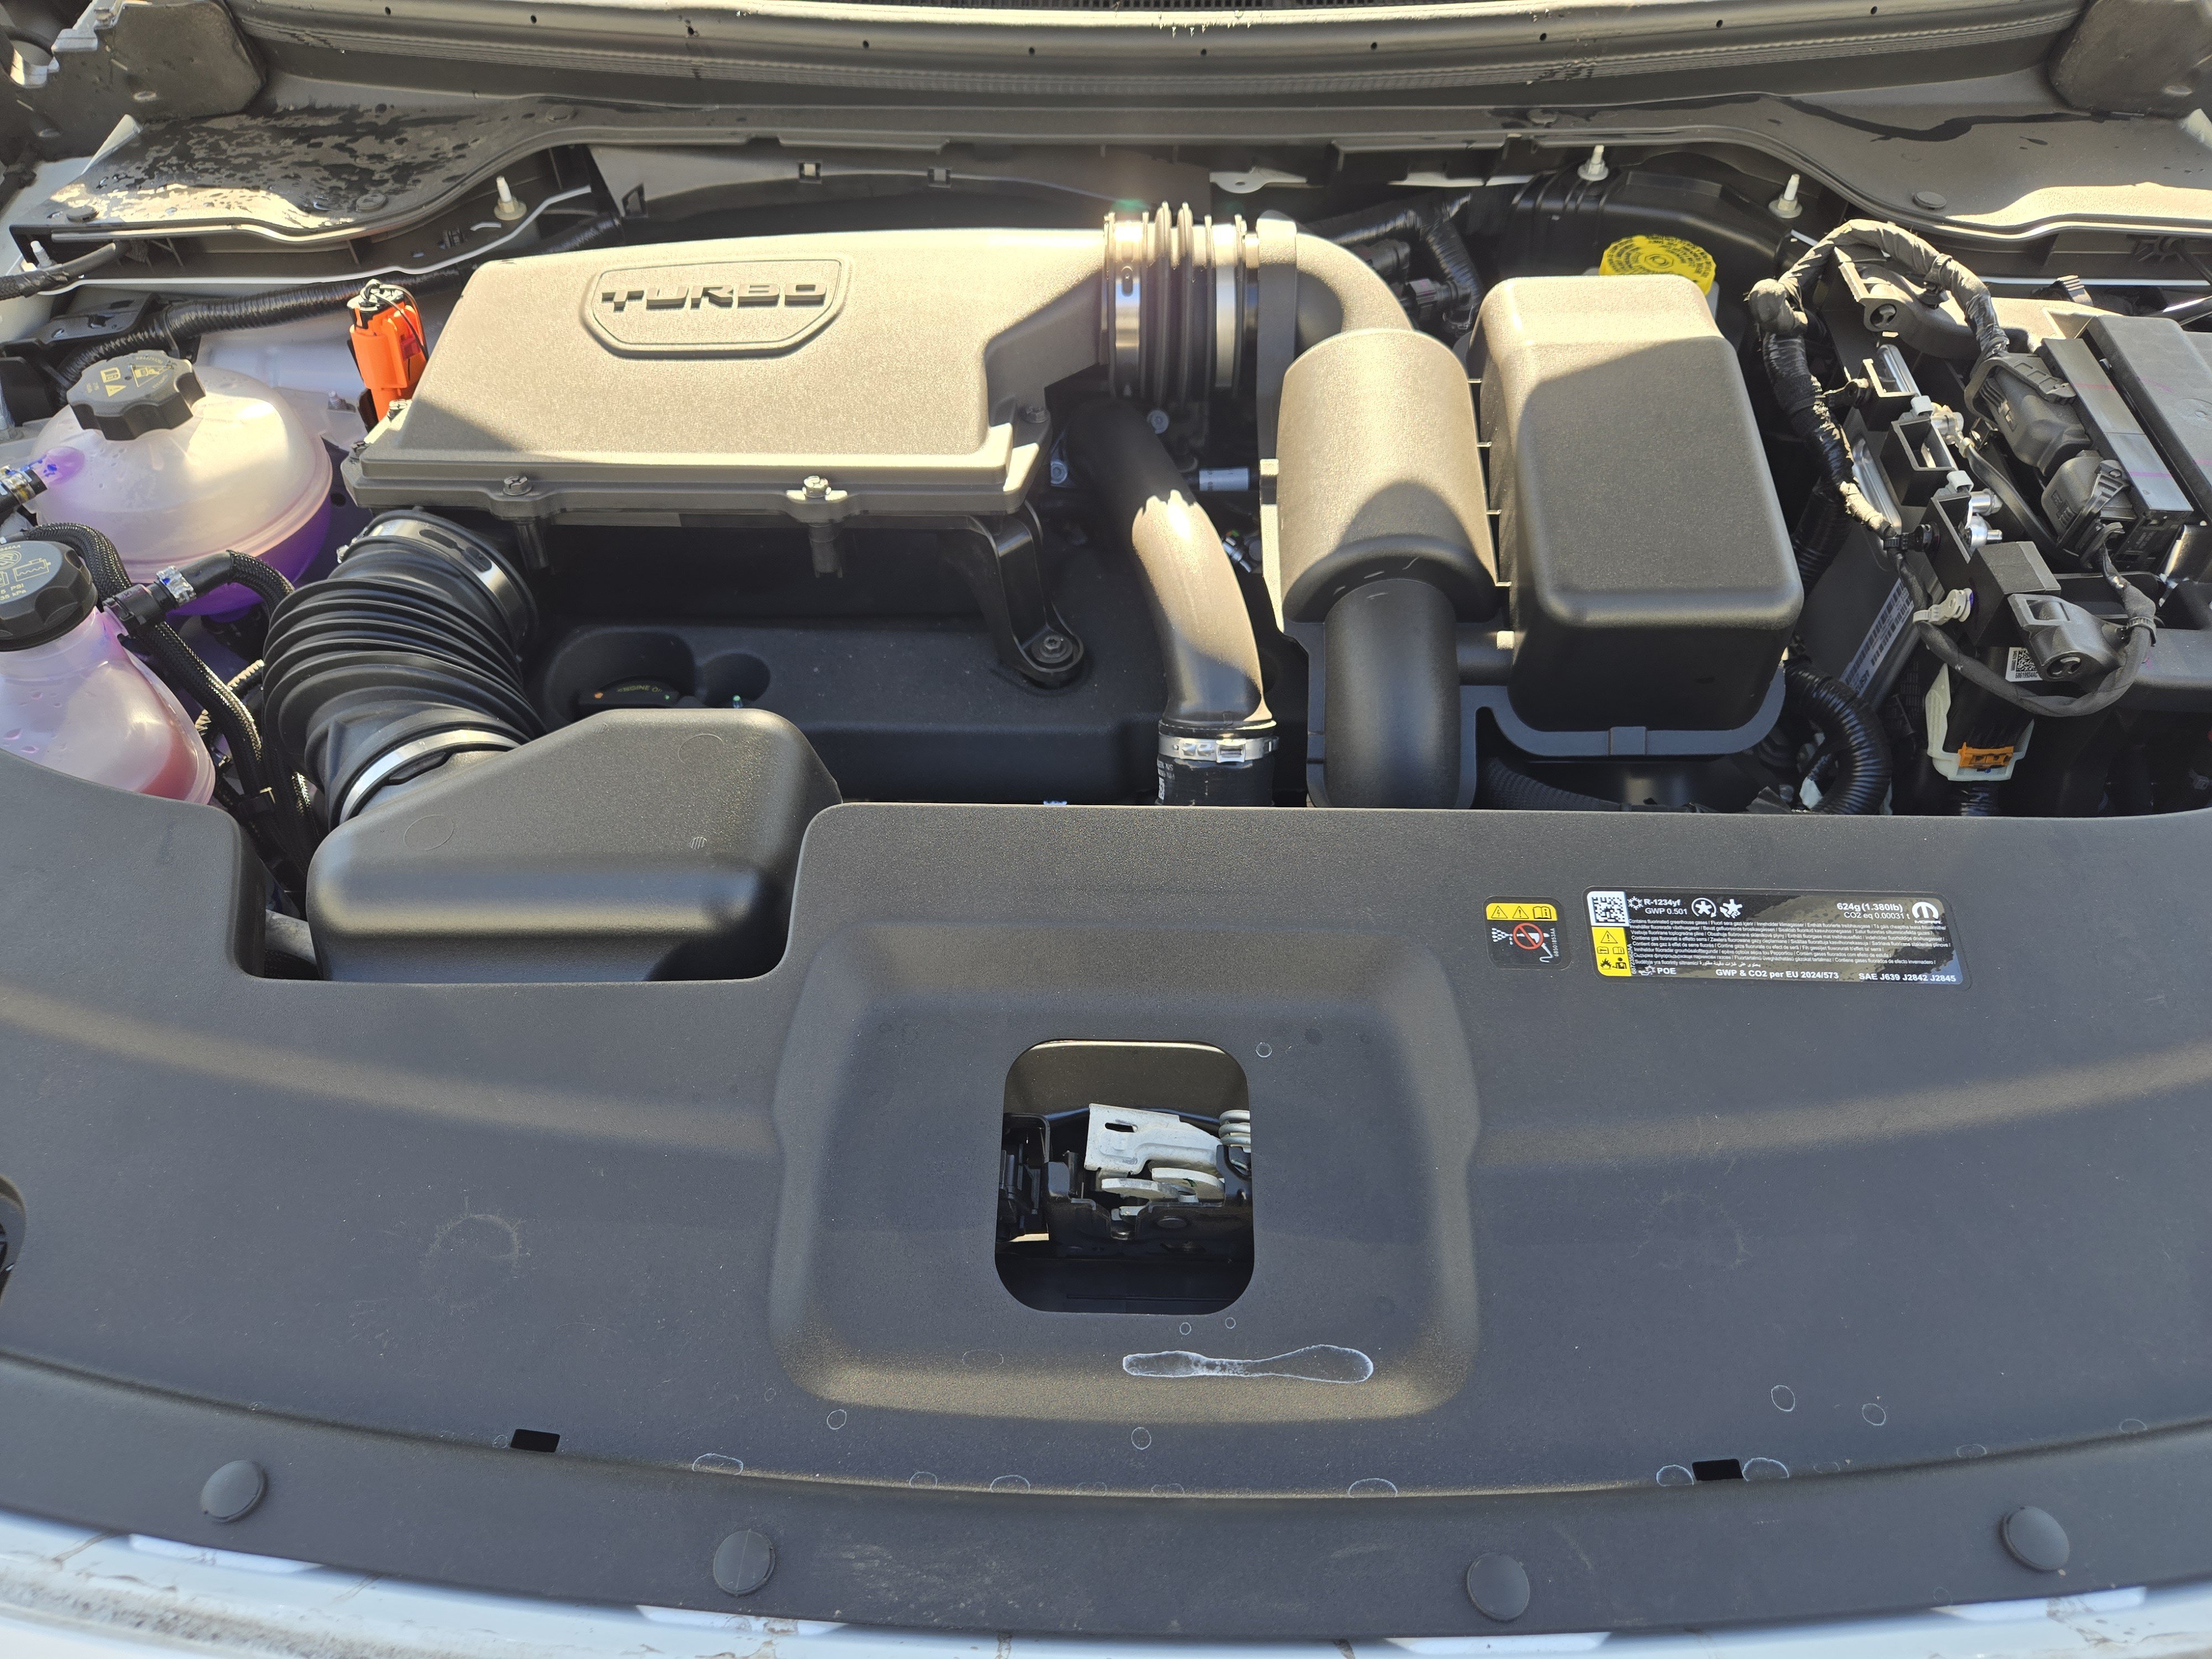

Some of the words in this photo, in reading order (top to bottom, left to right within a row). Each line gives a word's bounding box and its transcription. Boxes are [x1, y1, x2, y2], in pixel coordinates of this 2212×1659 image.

[602, 283, 827, 313] TURBO
[1644, 899, 1681, 907] R-1234yf
[1837, 902, 1860, 911] 624g
[1862, 903, 1903, 912] (1.380lb)
